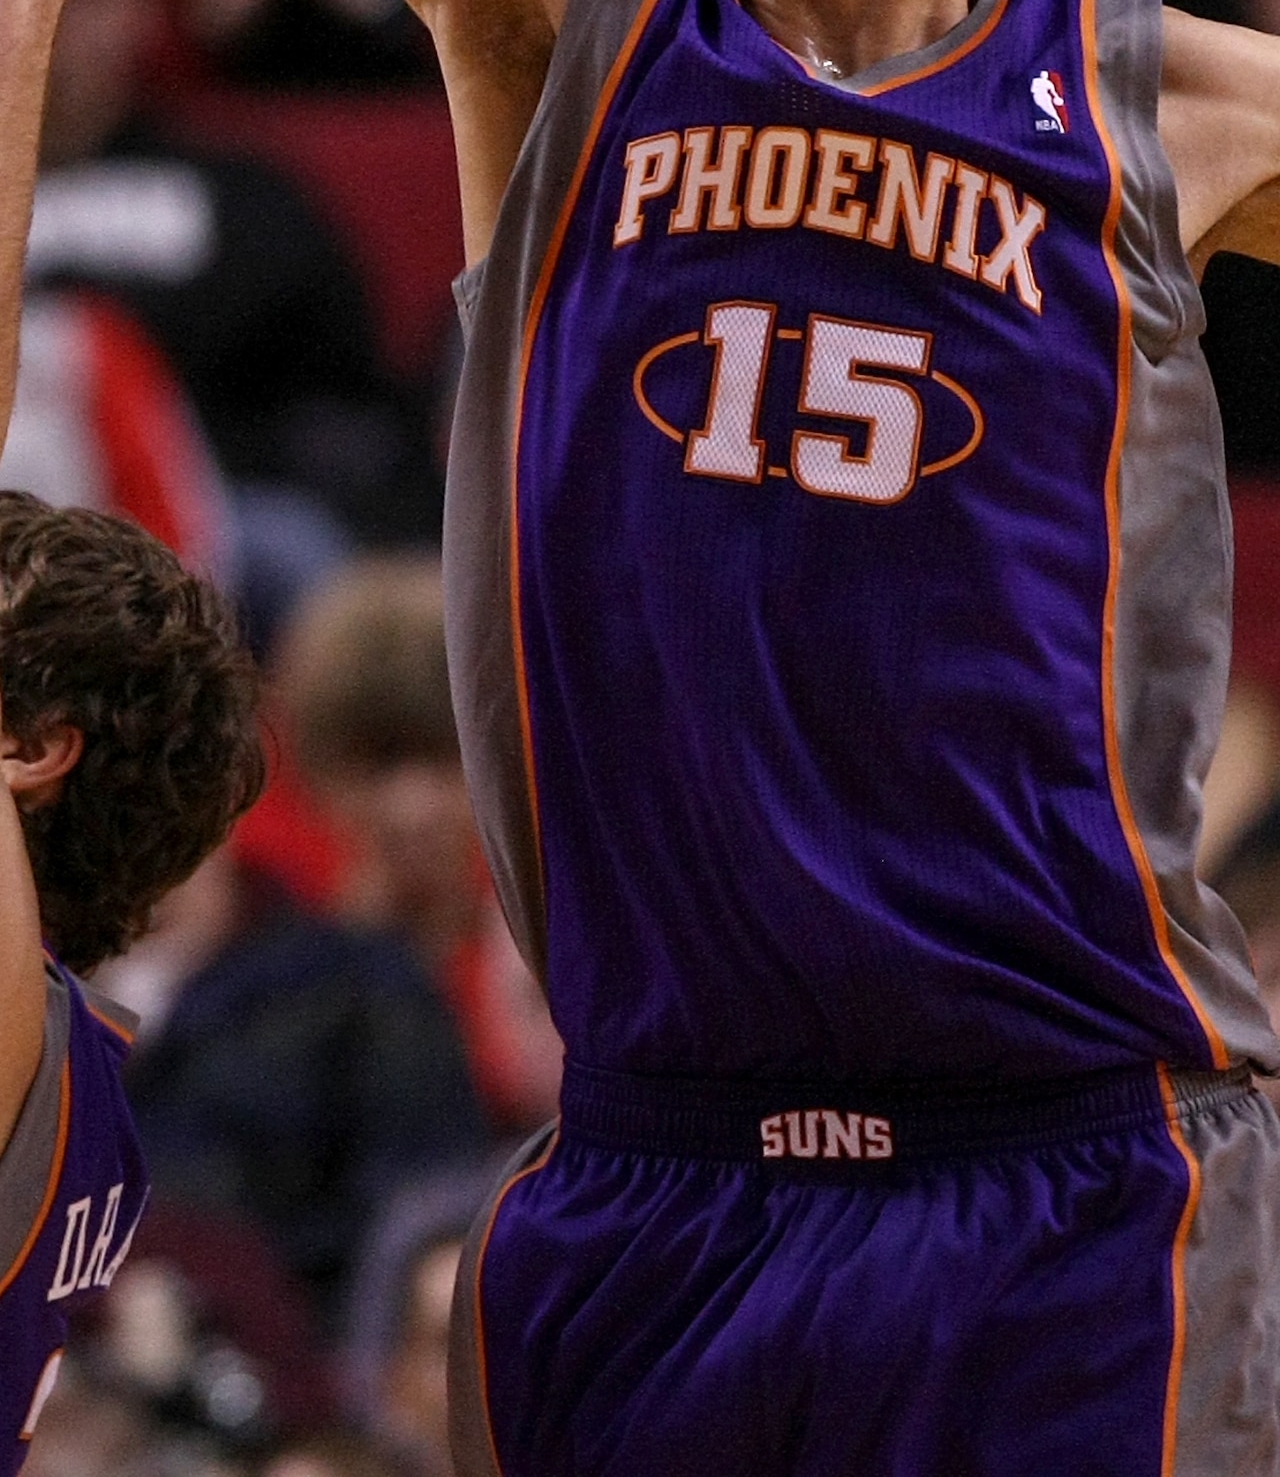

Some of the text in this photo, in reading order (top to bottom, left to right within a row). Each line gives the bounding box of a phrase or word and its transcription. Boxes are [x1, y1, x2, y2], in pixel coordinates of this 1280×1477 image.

[1035, 119, 1059, 132] NBA
[613, 125, 1047, 317] PHOENIX
[682, 299, 934, 506] 15
[758, 1107, 895, 1161] SUNS
